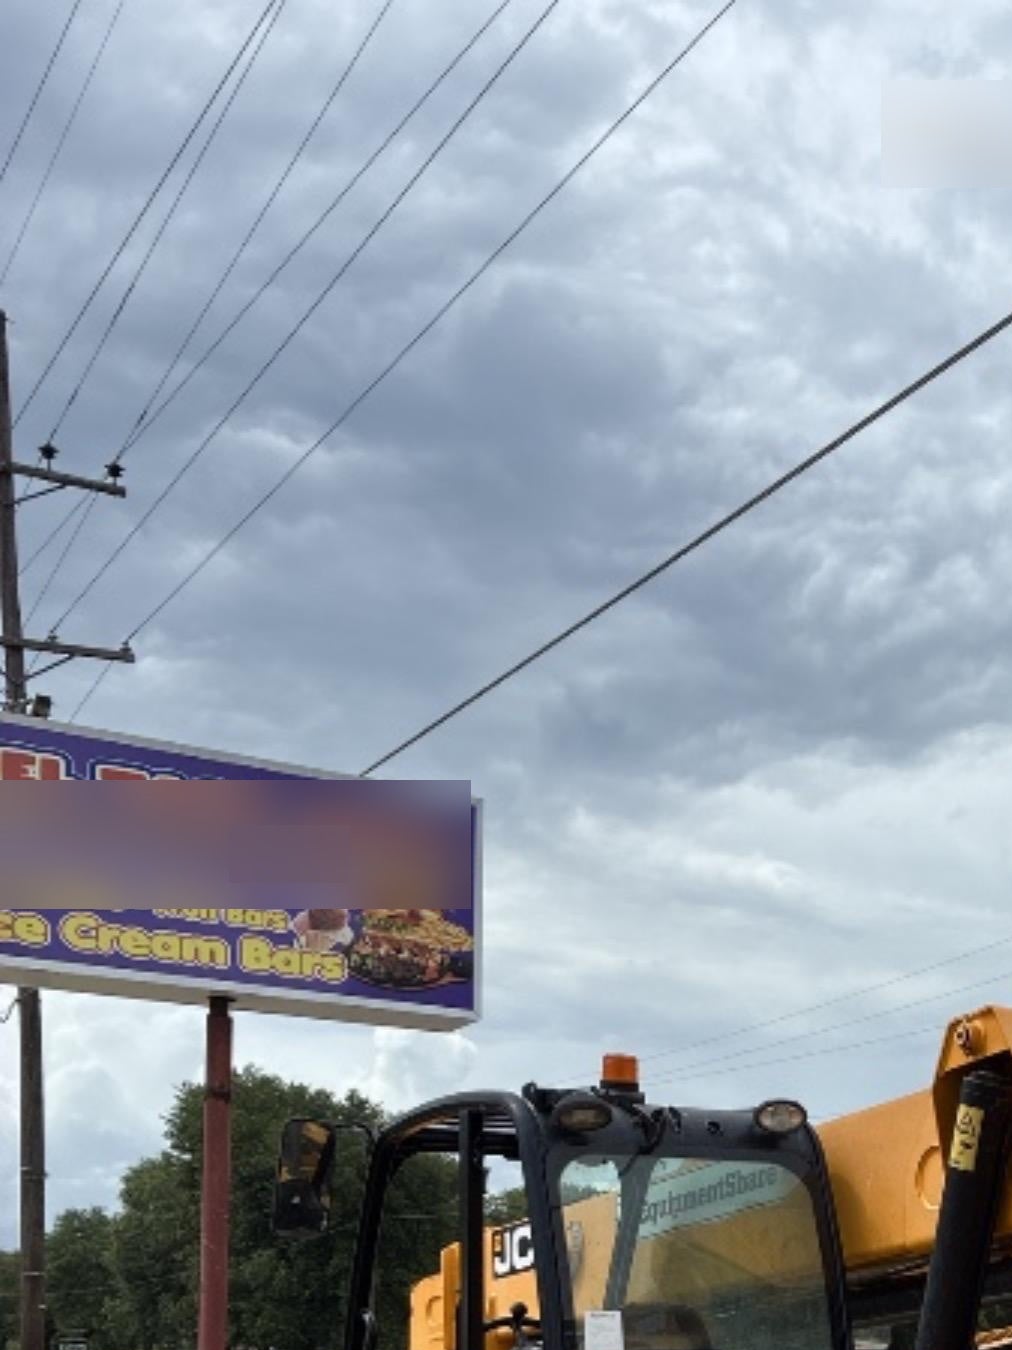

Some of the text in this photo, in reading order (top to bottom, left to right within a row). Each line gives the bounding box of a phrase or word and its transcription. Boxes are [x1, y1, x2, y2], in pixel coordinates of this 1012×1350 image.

[60, 913, 228, 967] Cream
[240, 936, 348, 982] Bars
[494, 1223, 536, 1275] JC
